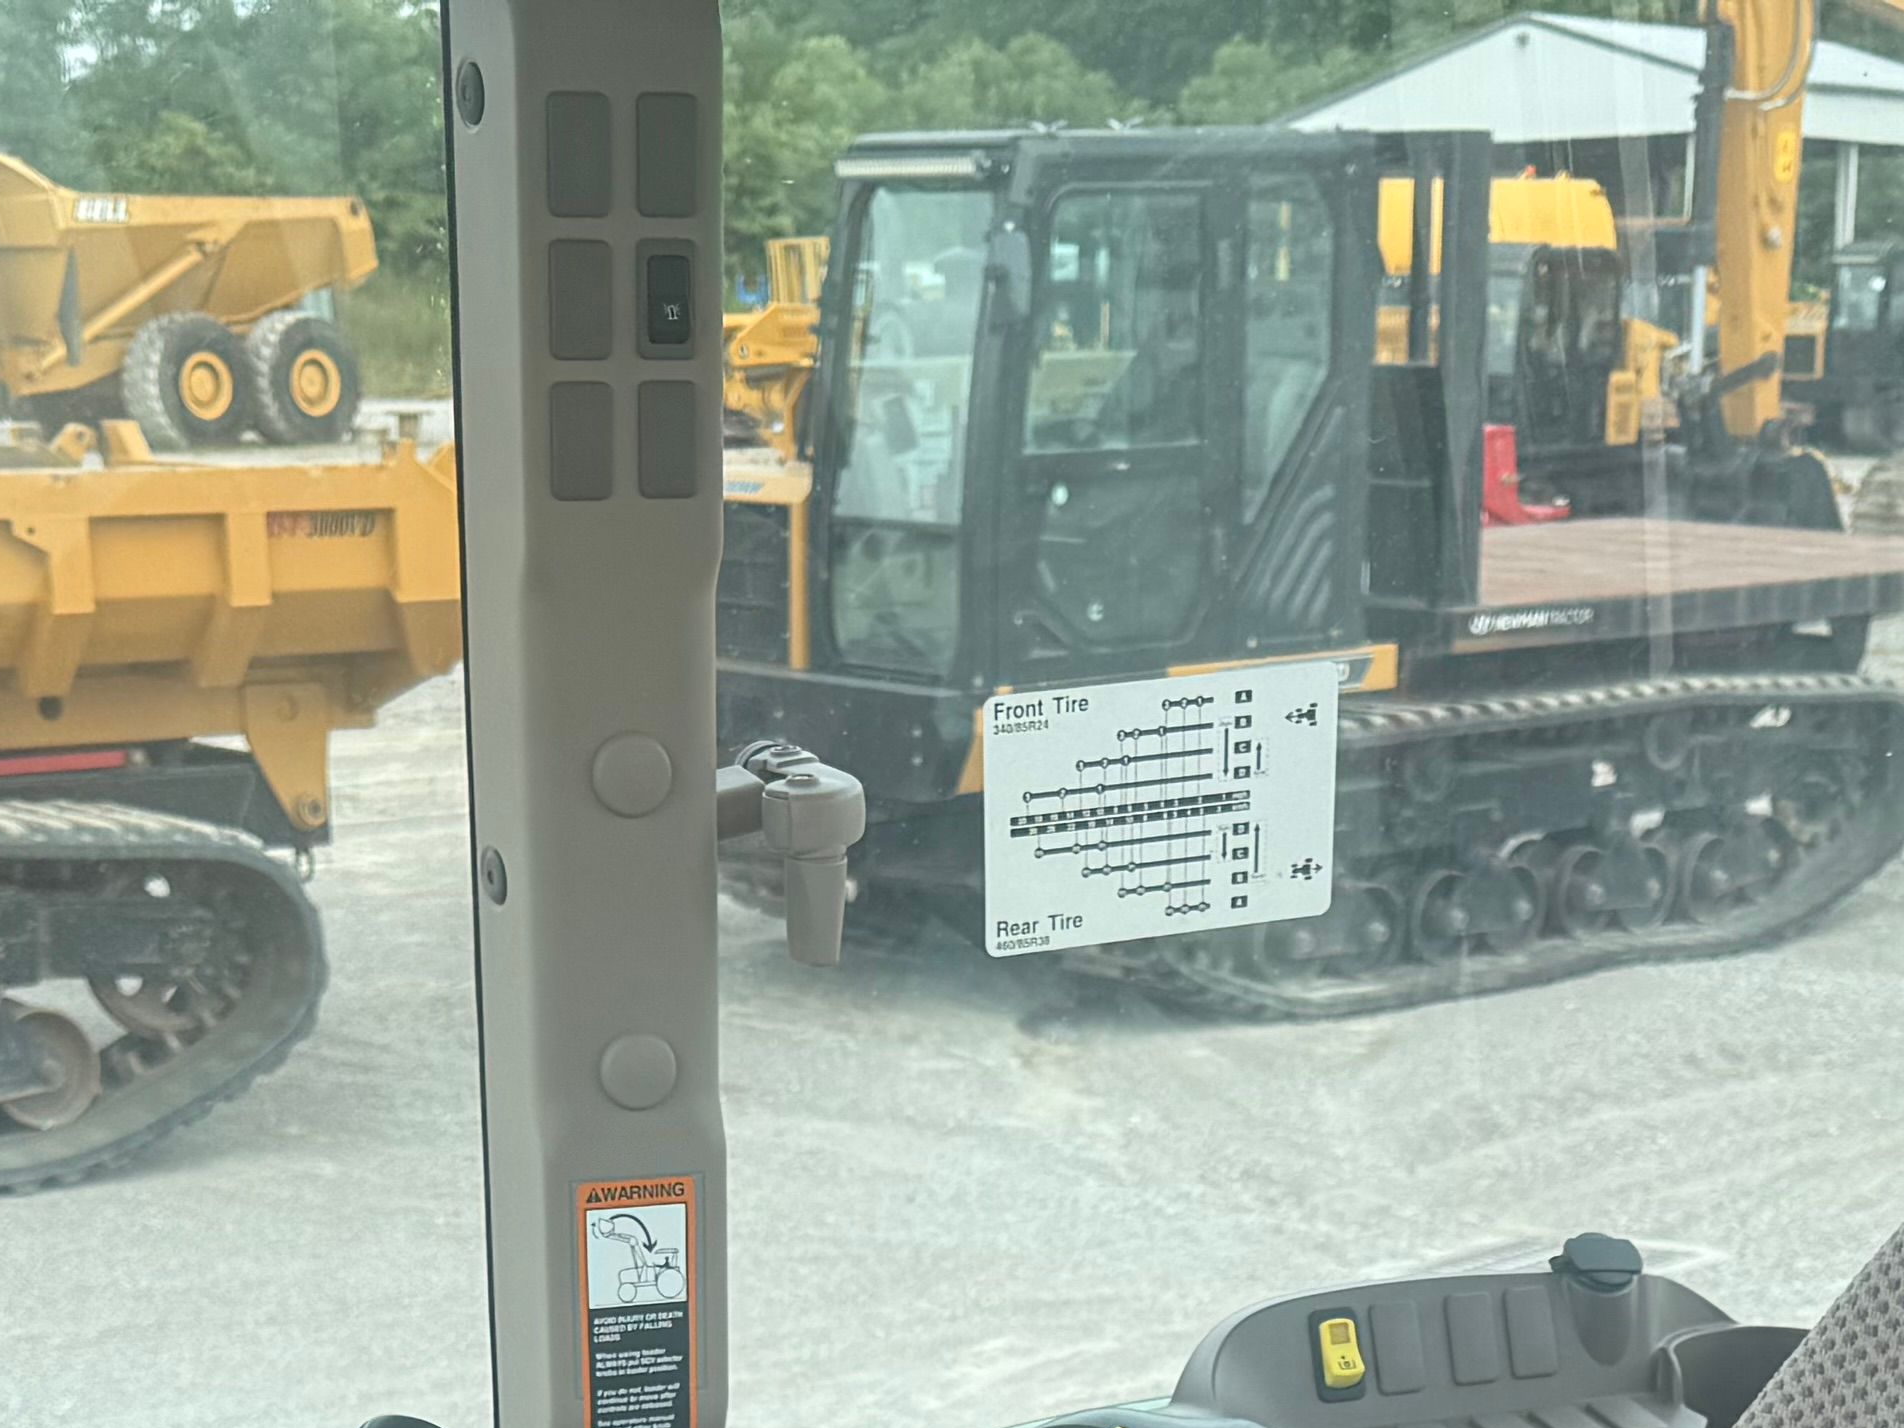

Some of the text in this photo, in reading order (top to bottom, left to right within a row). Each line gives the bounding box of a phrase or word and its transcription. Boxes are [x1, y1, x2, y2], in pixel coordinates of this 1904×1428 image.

[993, 696, 1089, 721] Front Tire
[996, 914, 1084, 938] Rear Tire
[600, 1181, 685, 1202] WARNING
